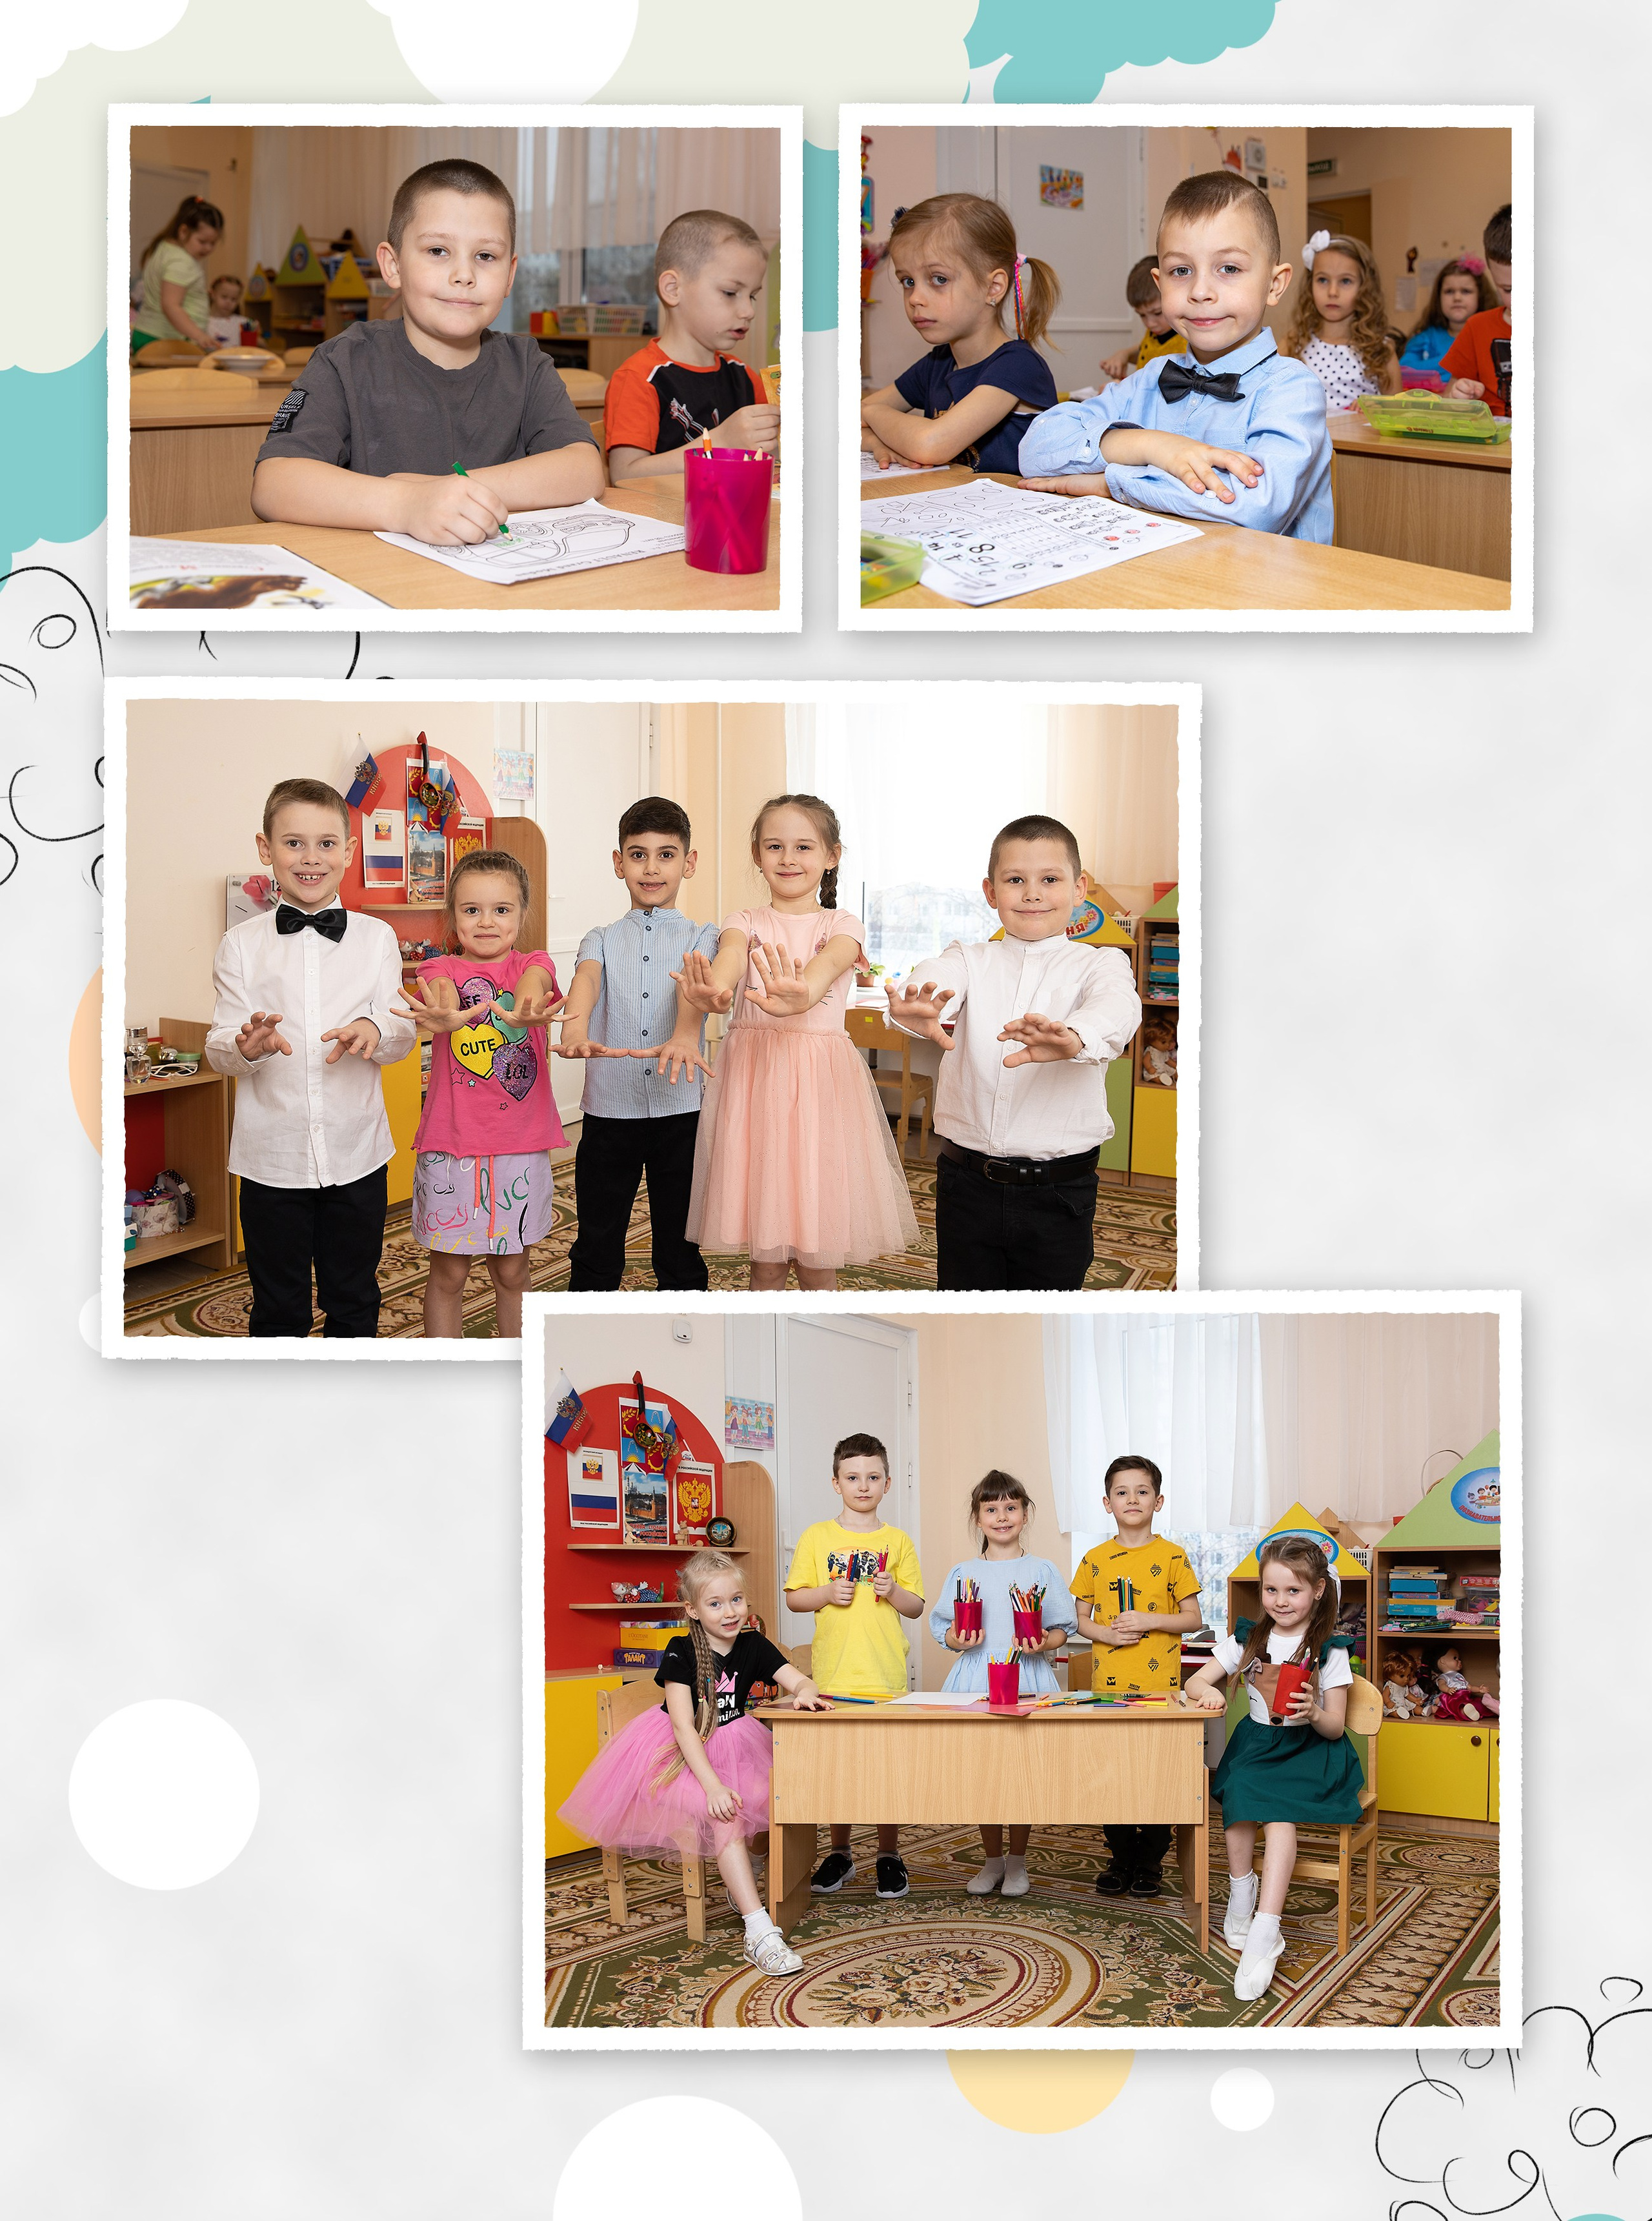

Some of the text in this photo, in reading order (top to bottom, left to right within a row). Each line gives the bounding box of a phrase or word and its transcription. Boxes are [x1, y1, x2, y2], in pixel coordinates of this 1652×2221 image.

[949, 529, 974, 538] 11
[927, 542, 944, 551] 14
[969, 543, 995, 553] 8
[969, 556, 1000, 567] 15
[460, 1038, 497, 1057] CUTE
[505, 1062, 529, 1080] LOL
[624, 1652, 646, 1665] ТАЛАНТ
